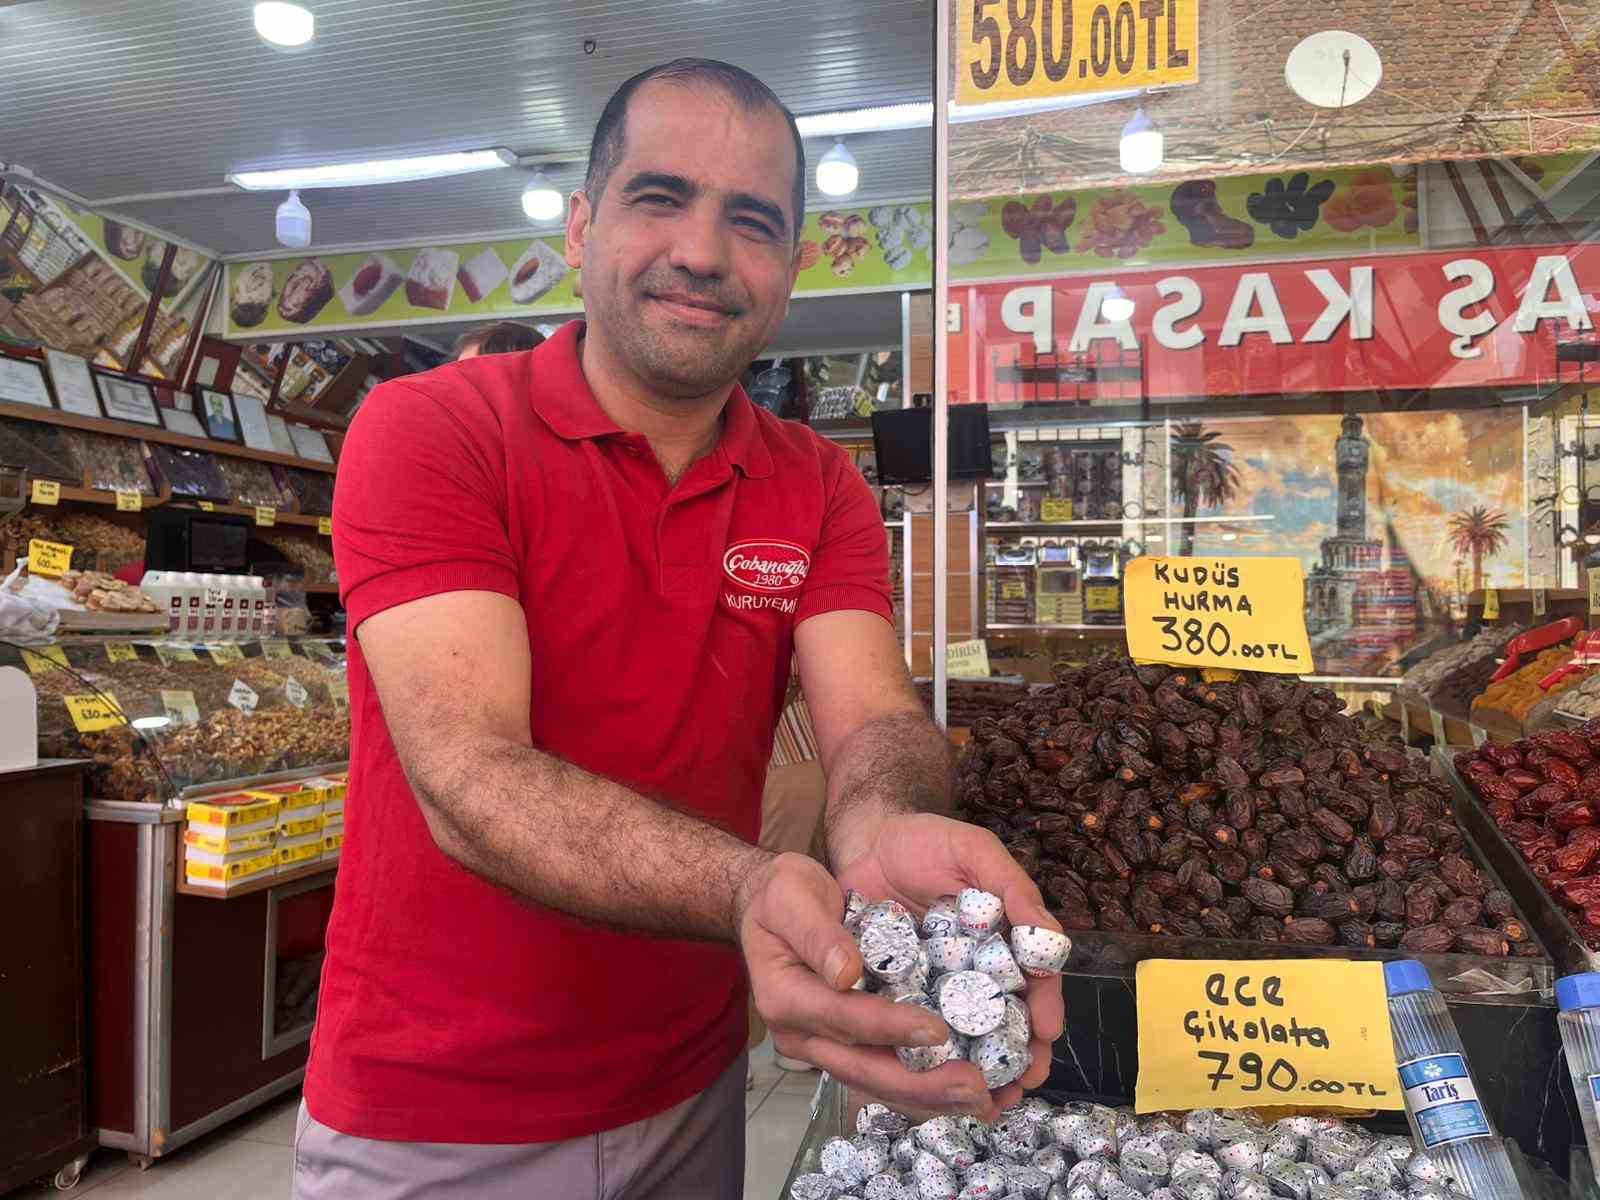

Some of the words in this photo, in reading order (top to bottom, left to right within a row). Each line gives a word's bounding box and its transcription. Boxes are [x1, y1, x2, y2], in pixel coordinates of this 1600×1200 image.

[754, 573, 783, 586] 1980
[1155, 562, 1240, 588] KUDÜS
[1164, 591, 1253, 616] HURMA
[1152, 617, 1298, 660] 380.00TL
[1198, 1050, 1388, 1096] 790.00TL
[1421, 1081, 1460, 1102] Tariş
